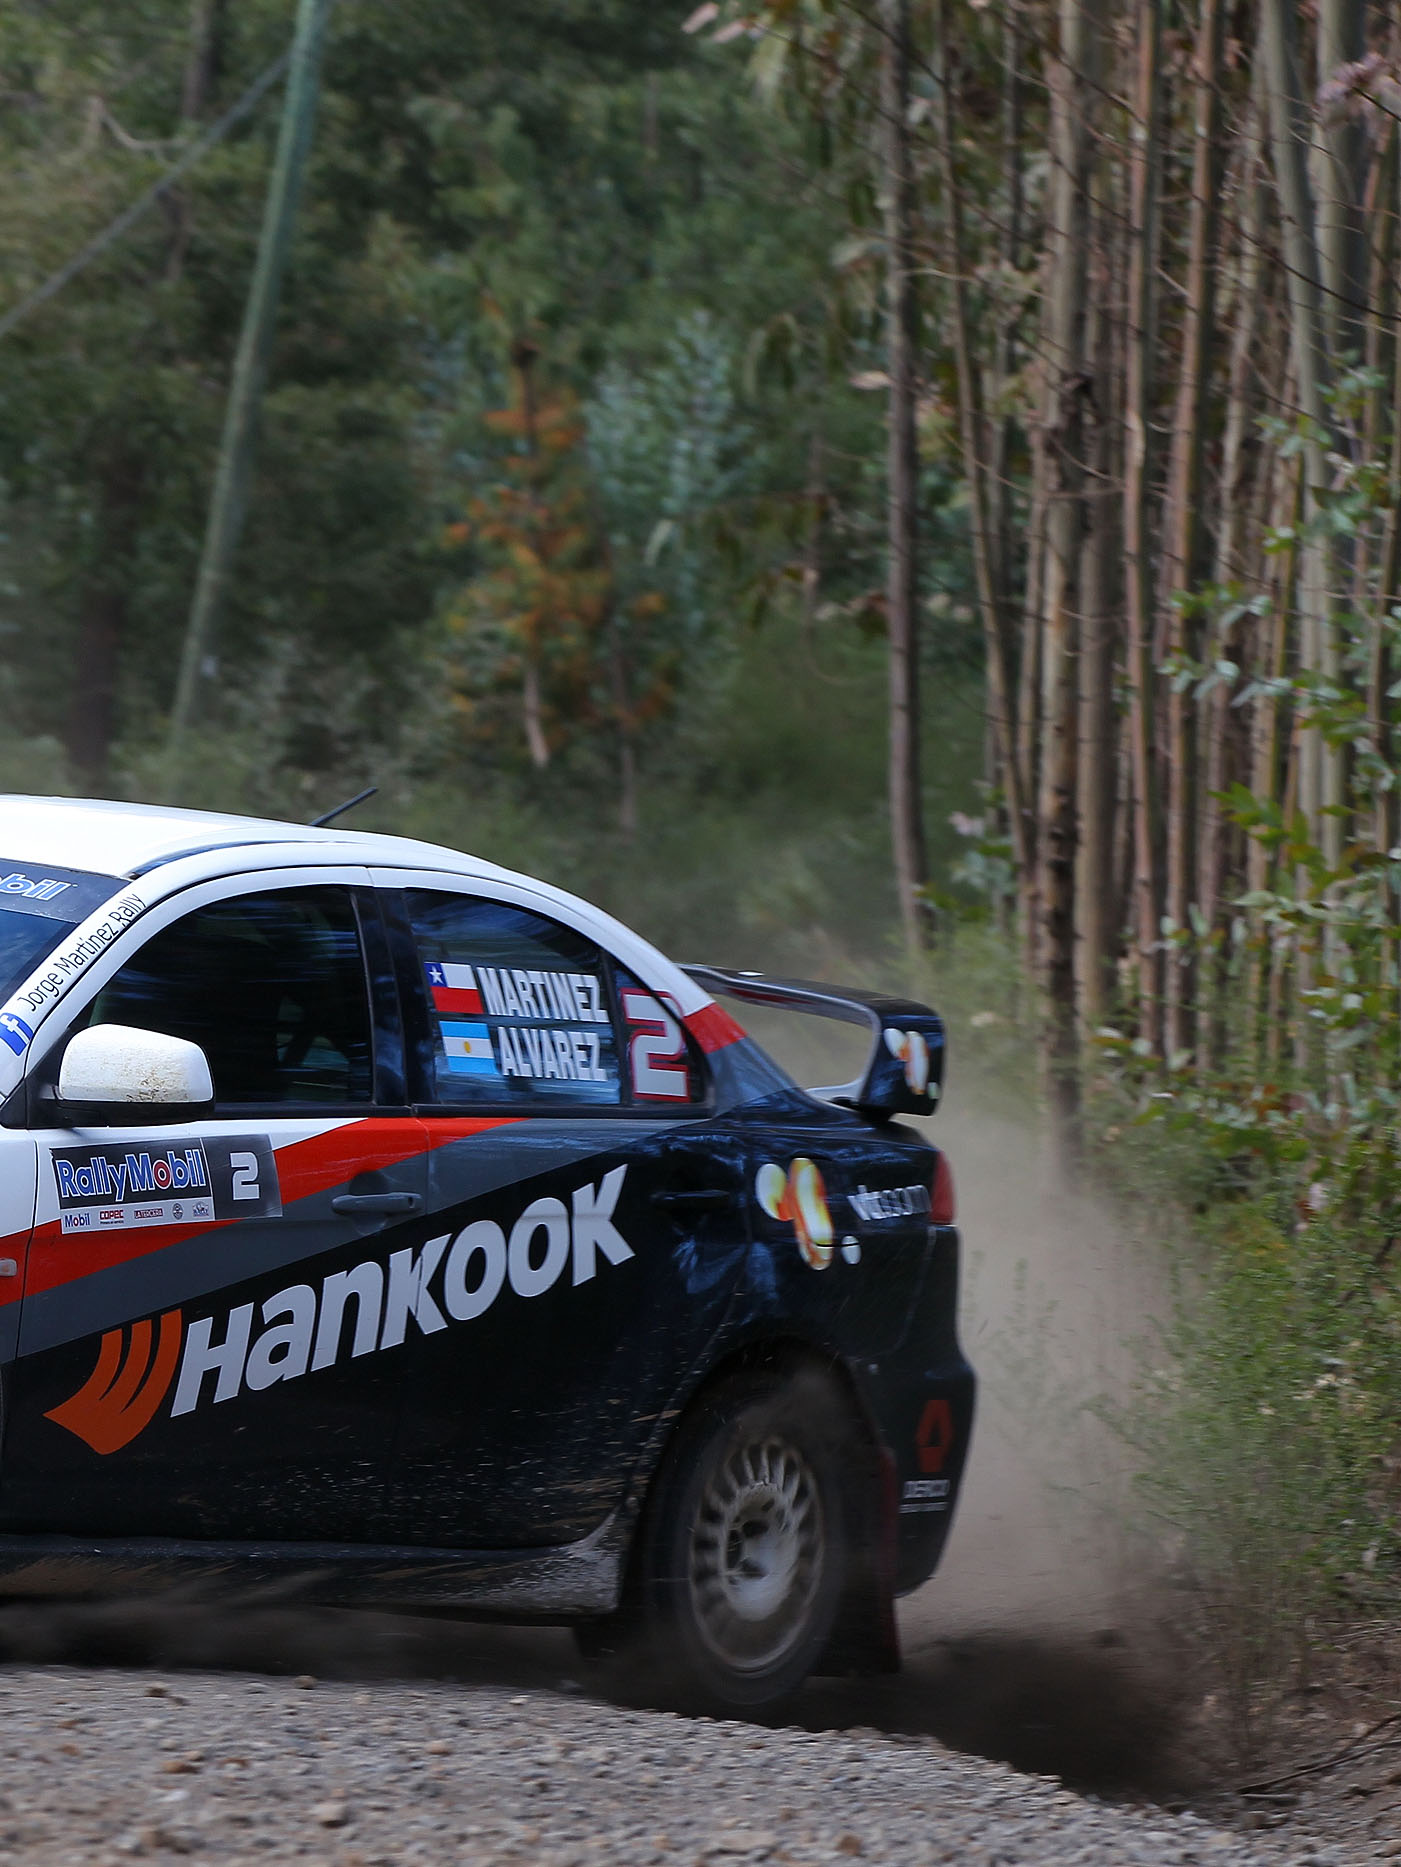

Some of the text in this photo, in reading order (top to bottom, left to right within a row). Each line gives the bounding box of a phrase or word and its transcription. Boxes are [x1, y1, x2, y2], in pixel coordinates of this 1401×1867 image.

[17, 972, 64, 1012] Jorge
[109, 893, 148, 928] Rally
[476, 966, 611, 1023] MARTINEZ
[497, 1026, 608, 1082] ALVAREZ
[620, 987, 691, 1103] 2
[229, 1152, 261, 1201] 2
[64, 1212, 91, 1229] Mobil
